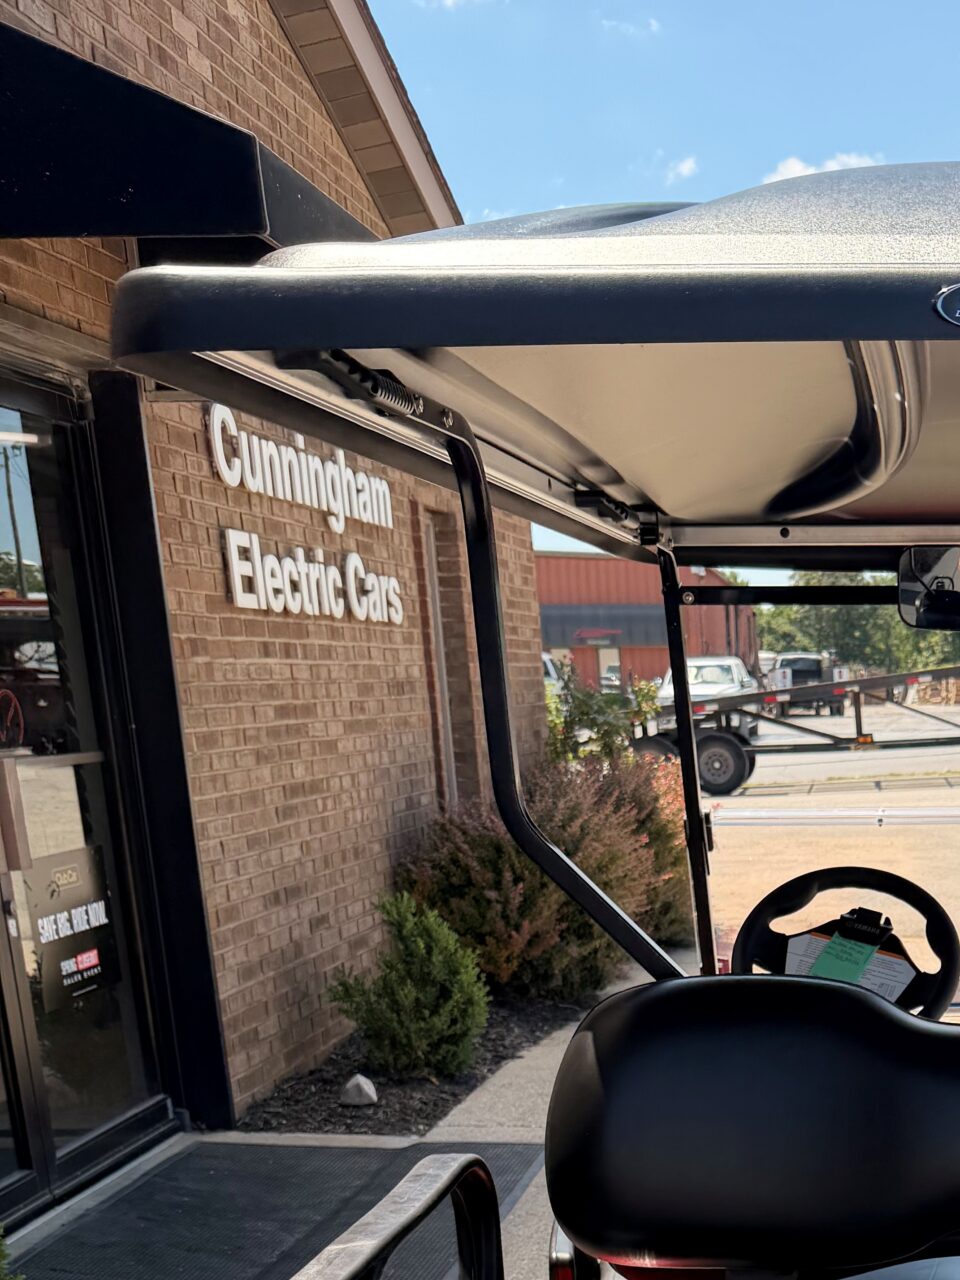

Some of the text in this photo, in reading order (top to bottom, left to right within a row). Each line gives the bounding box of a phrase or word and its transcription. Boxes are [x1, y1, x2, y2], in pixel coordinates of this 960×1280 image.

[210, 403, 394, 535] Cunningham
[225, 528, 404, 625] Electric Cars
